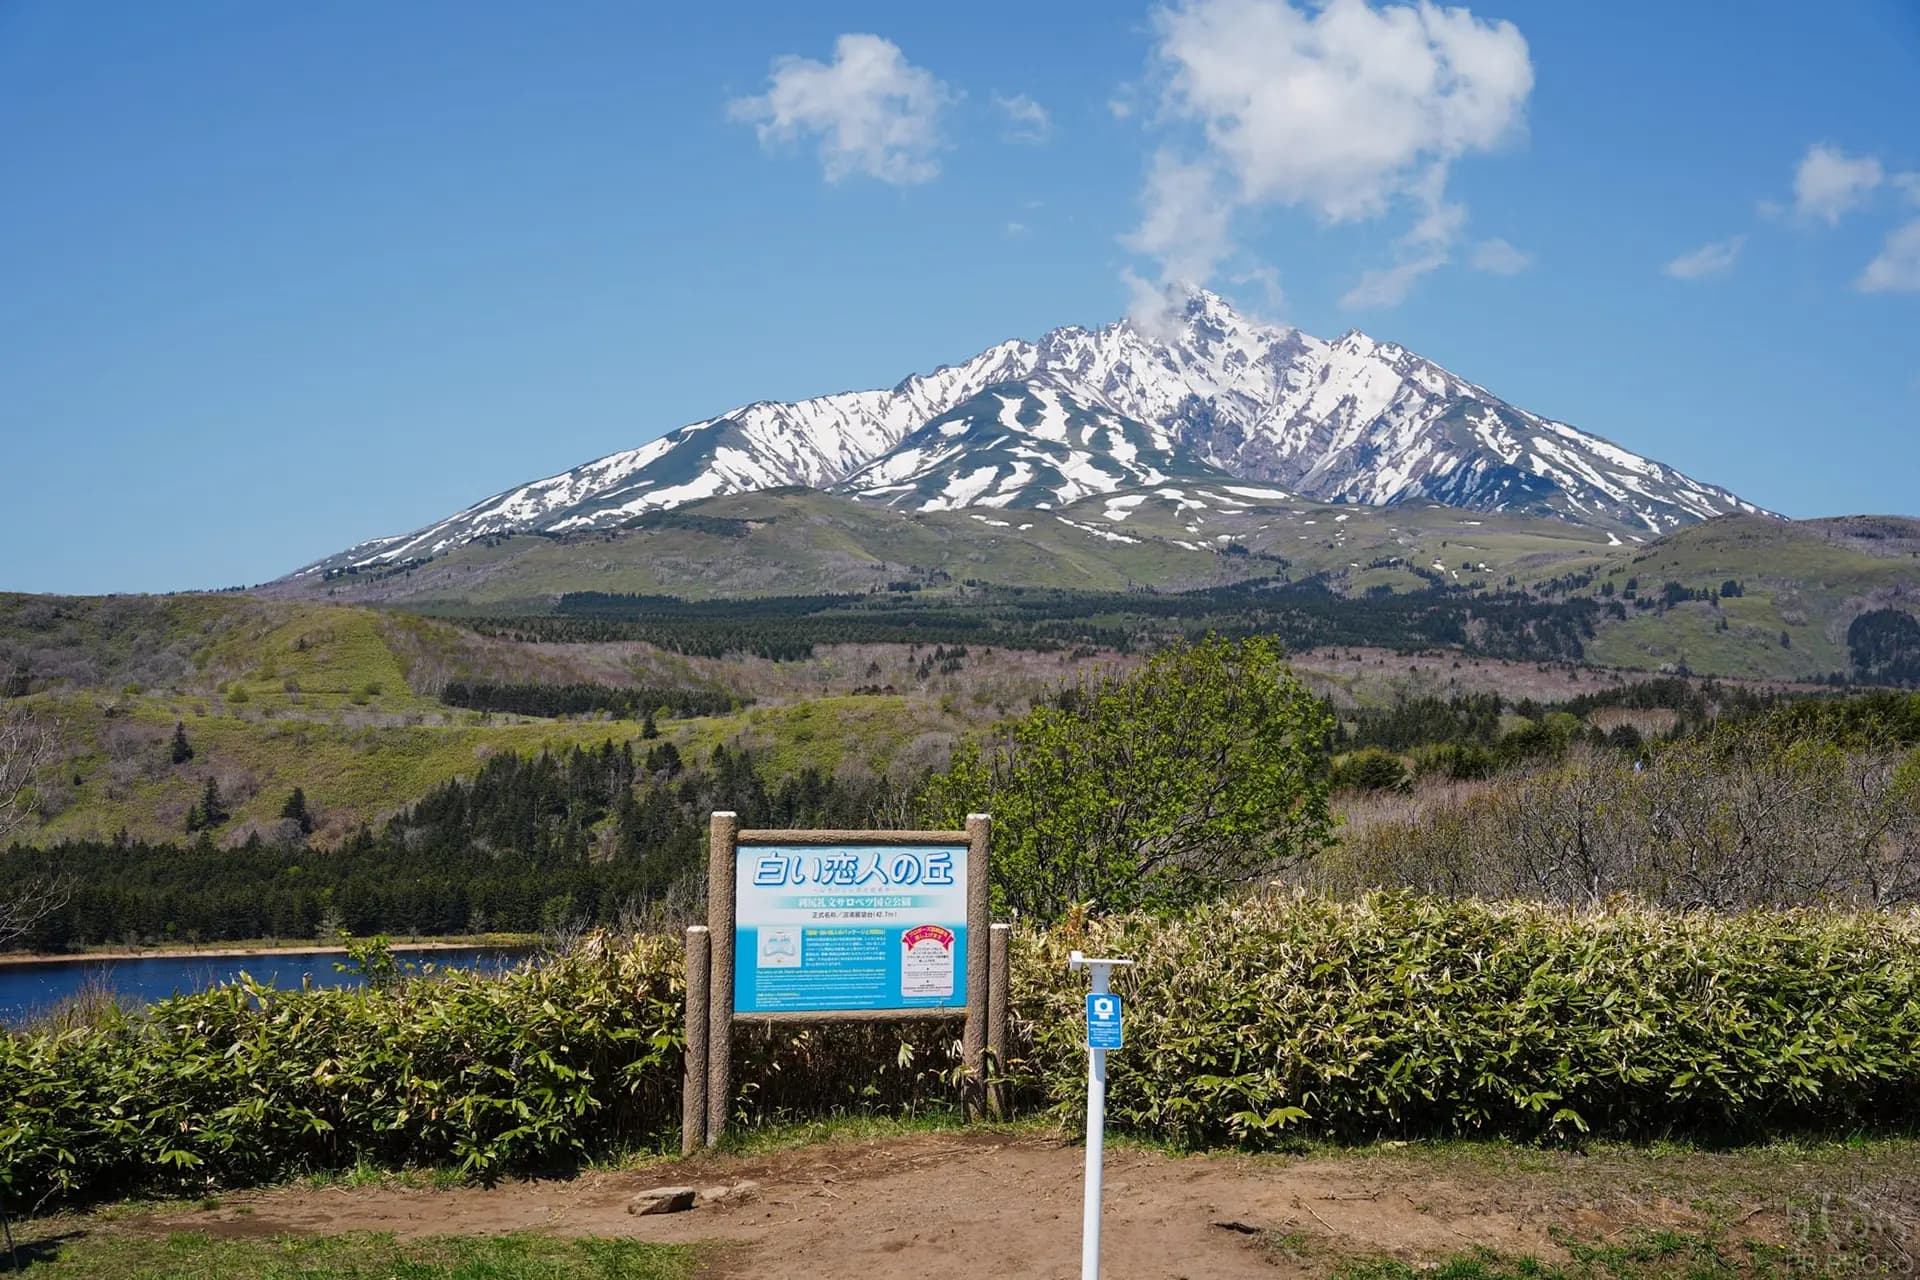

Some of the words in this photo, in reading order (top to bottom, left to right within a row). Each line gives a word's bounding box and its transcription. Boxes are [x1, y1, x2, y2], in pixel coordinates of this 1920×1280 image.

[753, 852, 954, 886] 白い恋人の丘
